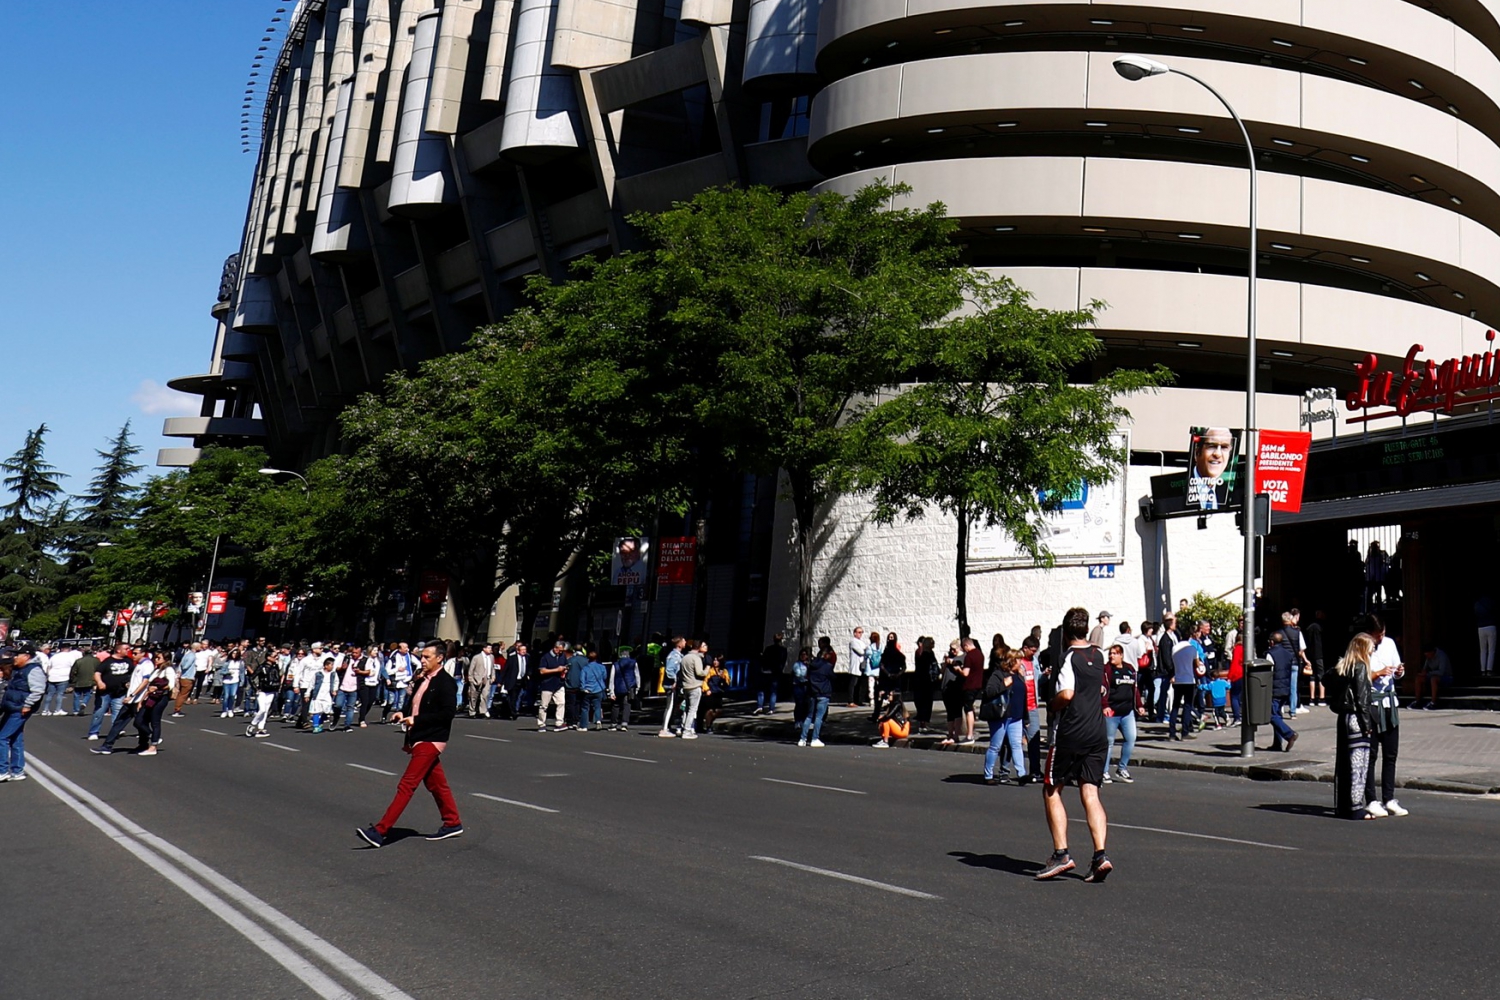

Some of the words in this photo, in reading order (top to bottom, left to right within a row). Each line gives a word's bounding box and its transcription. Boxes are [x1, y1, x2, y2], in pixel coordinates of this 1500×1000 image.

[1346, 354, 1393, 411] La
[1260, 452, 1303, 461] GABILONDO
[1189, 477, 1224, 486] CONTIGO
[1263, 480, 1289, 490] VOTA
[1188, 494, 1215, 502] CAMBIO
[1092, 565, 1109, 578] 44
[617, 577, 640, 585] PEPU
